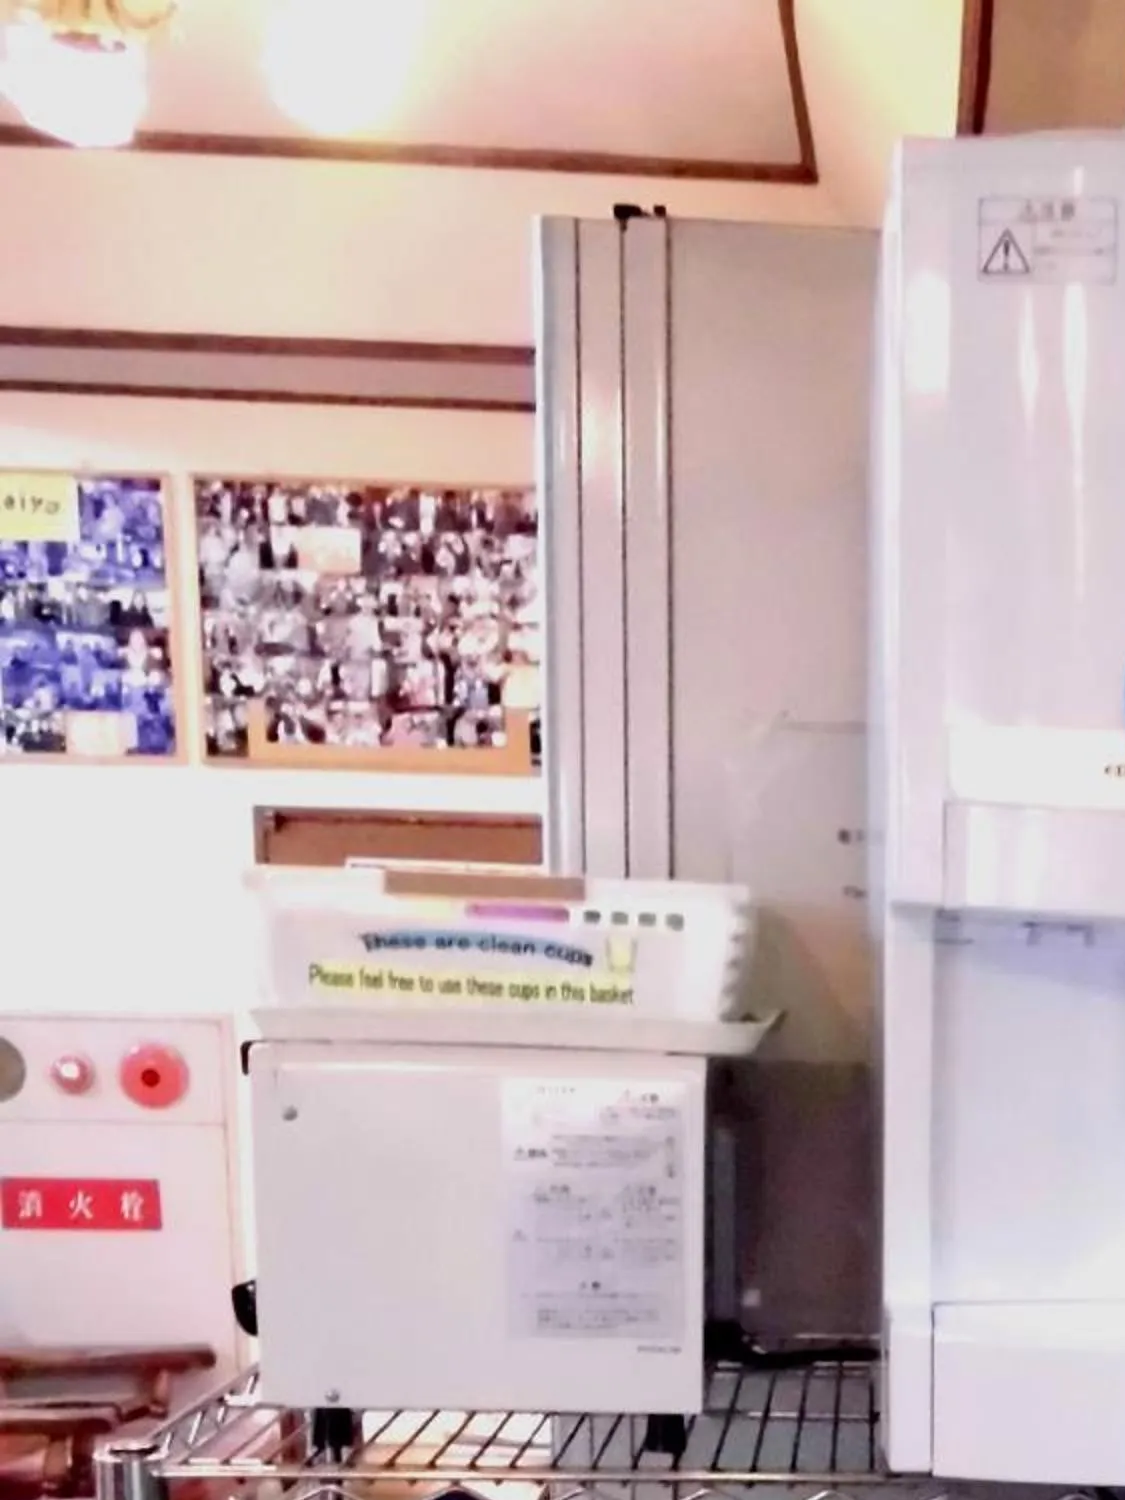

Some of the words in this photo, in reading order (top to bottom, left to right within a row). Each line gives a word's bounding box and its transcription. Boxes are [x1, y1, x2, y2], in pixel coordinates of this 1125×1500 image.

[358, 933, 426, 953] These
[436, 936, 470, 949] are
[480, 935, 535, 955] clean
[544, 942, 593, 967] cups
[309, 964, 353, 987] Please
[359, 965, 383, 987] feel
[388, 970, 414, 991] free
[420, 976, 434, 993] to
[439, 980, 461, 994] use
[466, 978, 503, 996] these
[508, 983, 540, 1000] cups
[545, 983, 558, 998] in
[561, 981, 585, 1001] this
[589, 984, 634, 1004] basket
[18, 1188, 146, 1222] 消火栓
